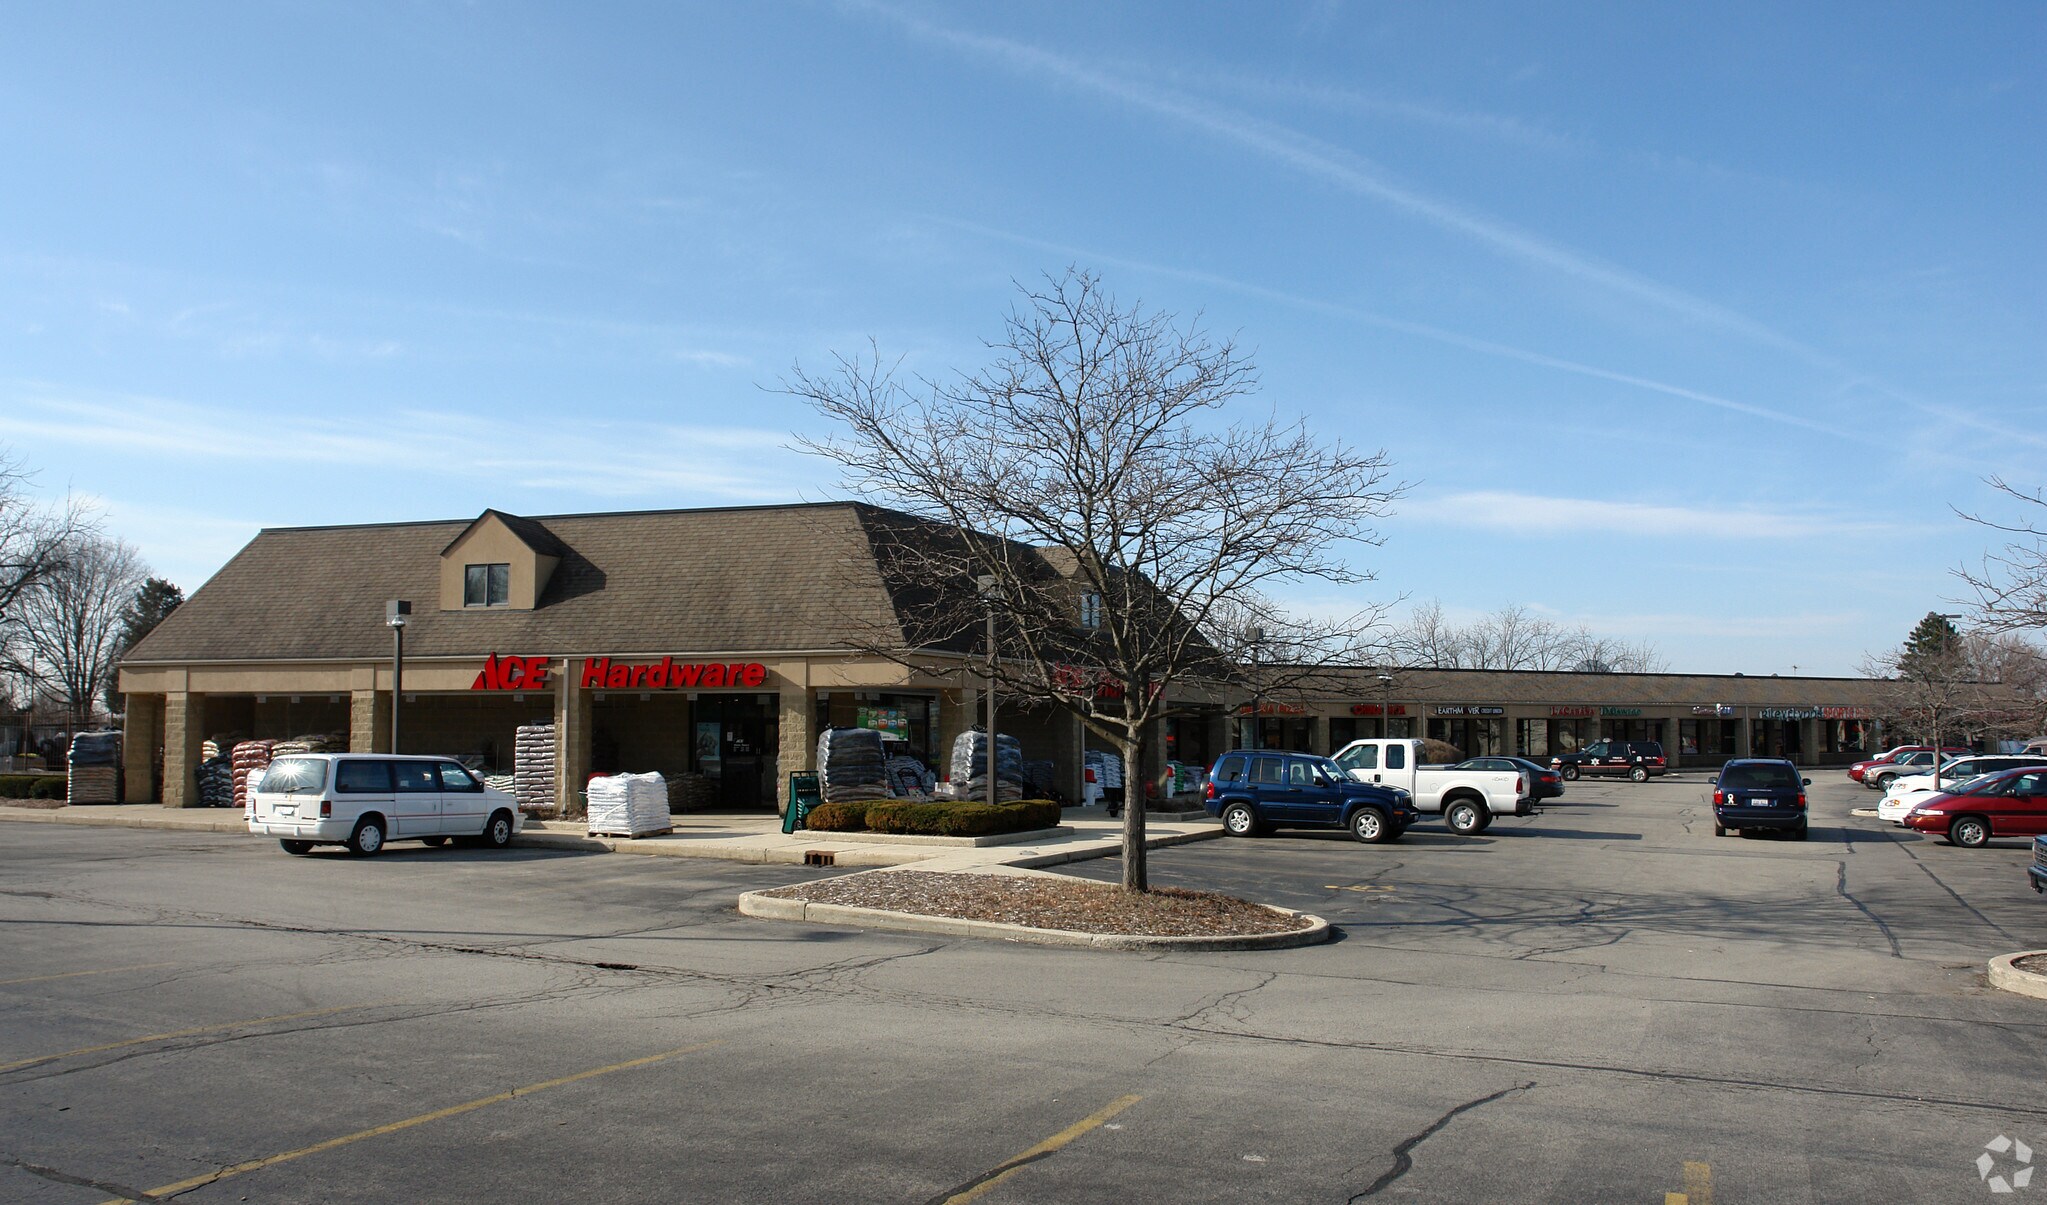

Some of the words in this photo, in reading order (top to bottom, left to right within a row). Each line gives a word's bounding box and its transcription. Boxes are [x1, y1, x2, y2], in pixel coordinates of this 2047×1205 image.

[470, 651, 550, 690] ACE
[580, 656, 767, 689] Hardware
[1437, 706, 1480, 715] EARTHMVER
